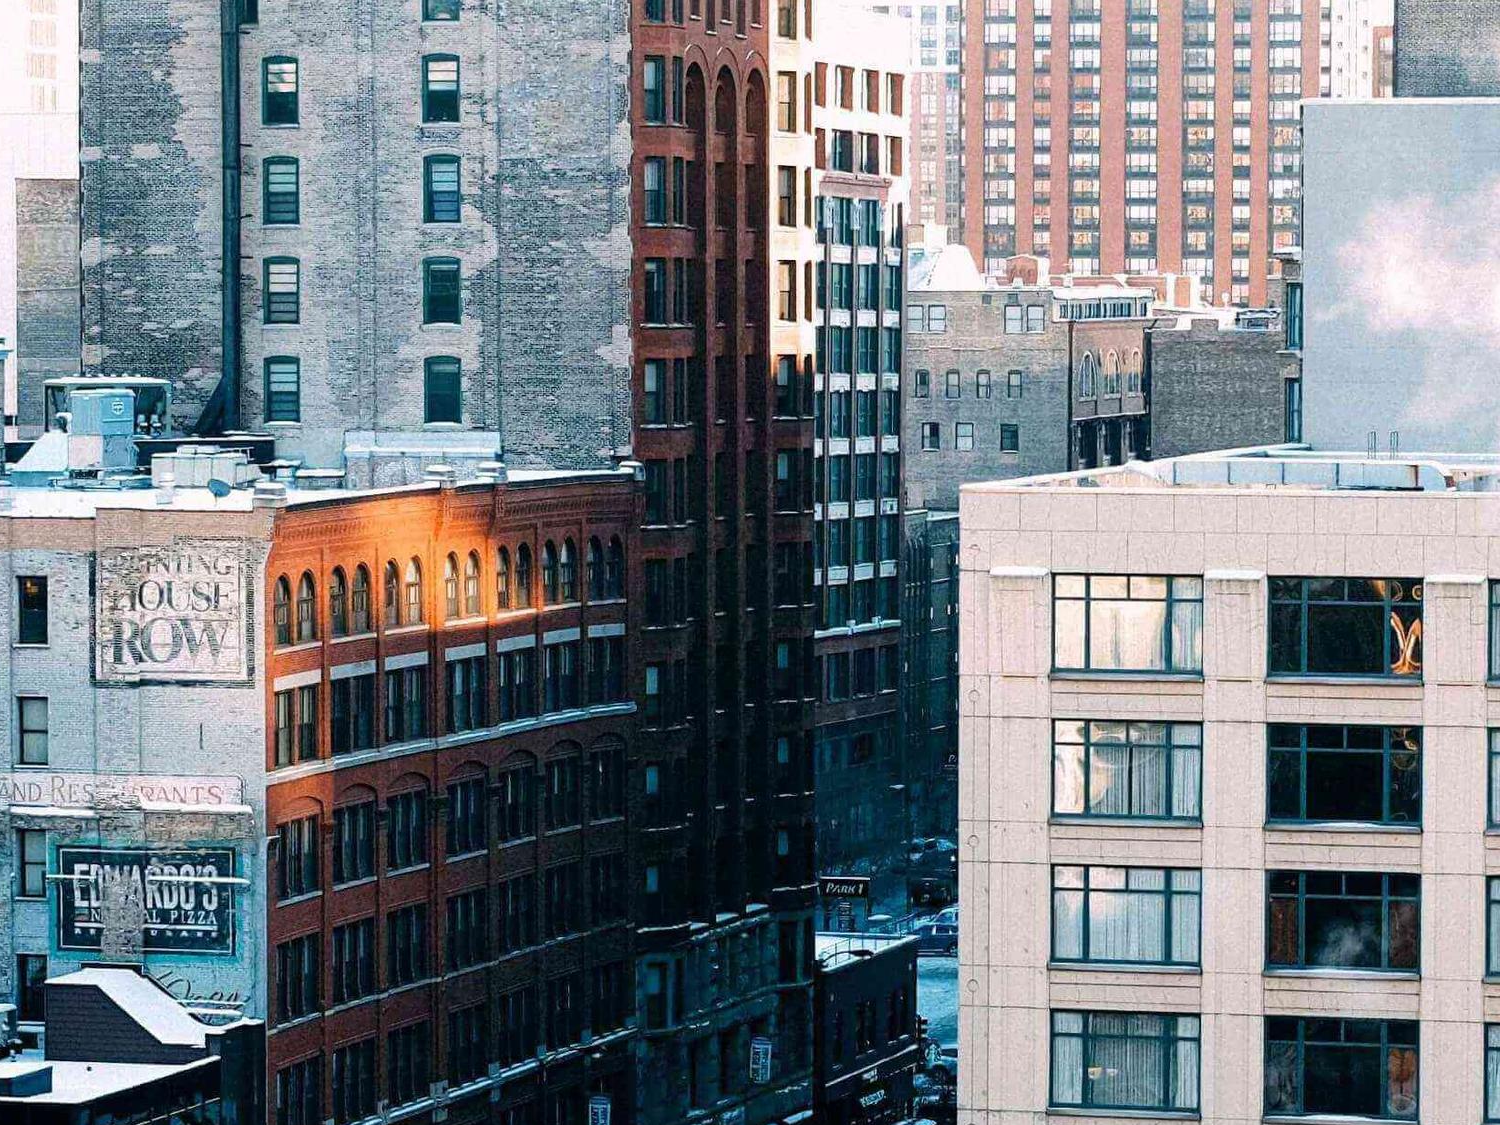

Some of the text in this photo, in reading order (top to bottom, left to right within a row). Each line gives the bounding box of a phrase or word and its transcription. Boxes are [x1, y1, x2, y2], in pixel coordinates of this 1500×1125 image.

[112, 616, 230, 665] ROW
[826, 882, 856, 895] PARK
[171, 909, 218, 926] PIZZA
